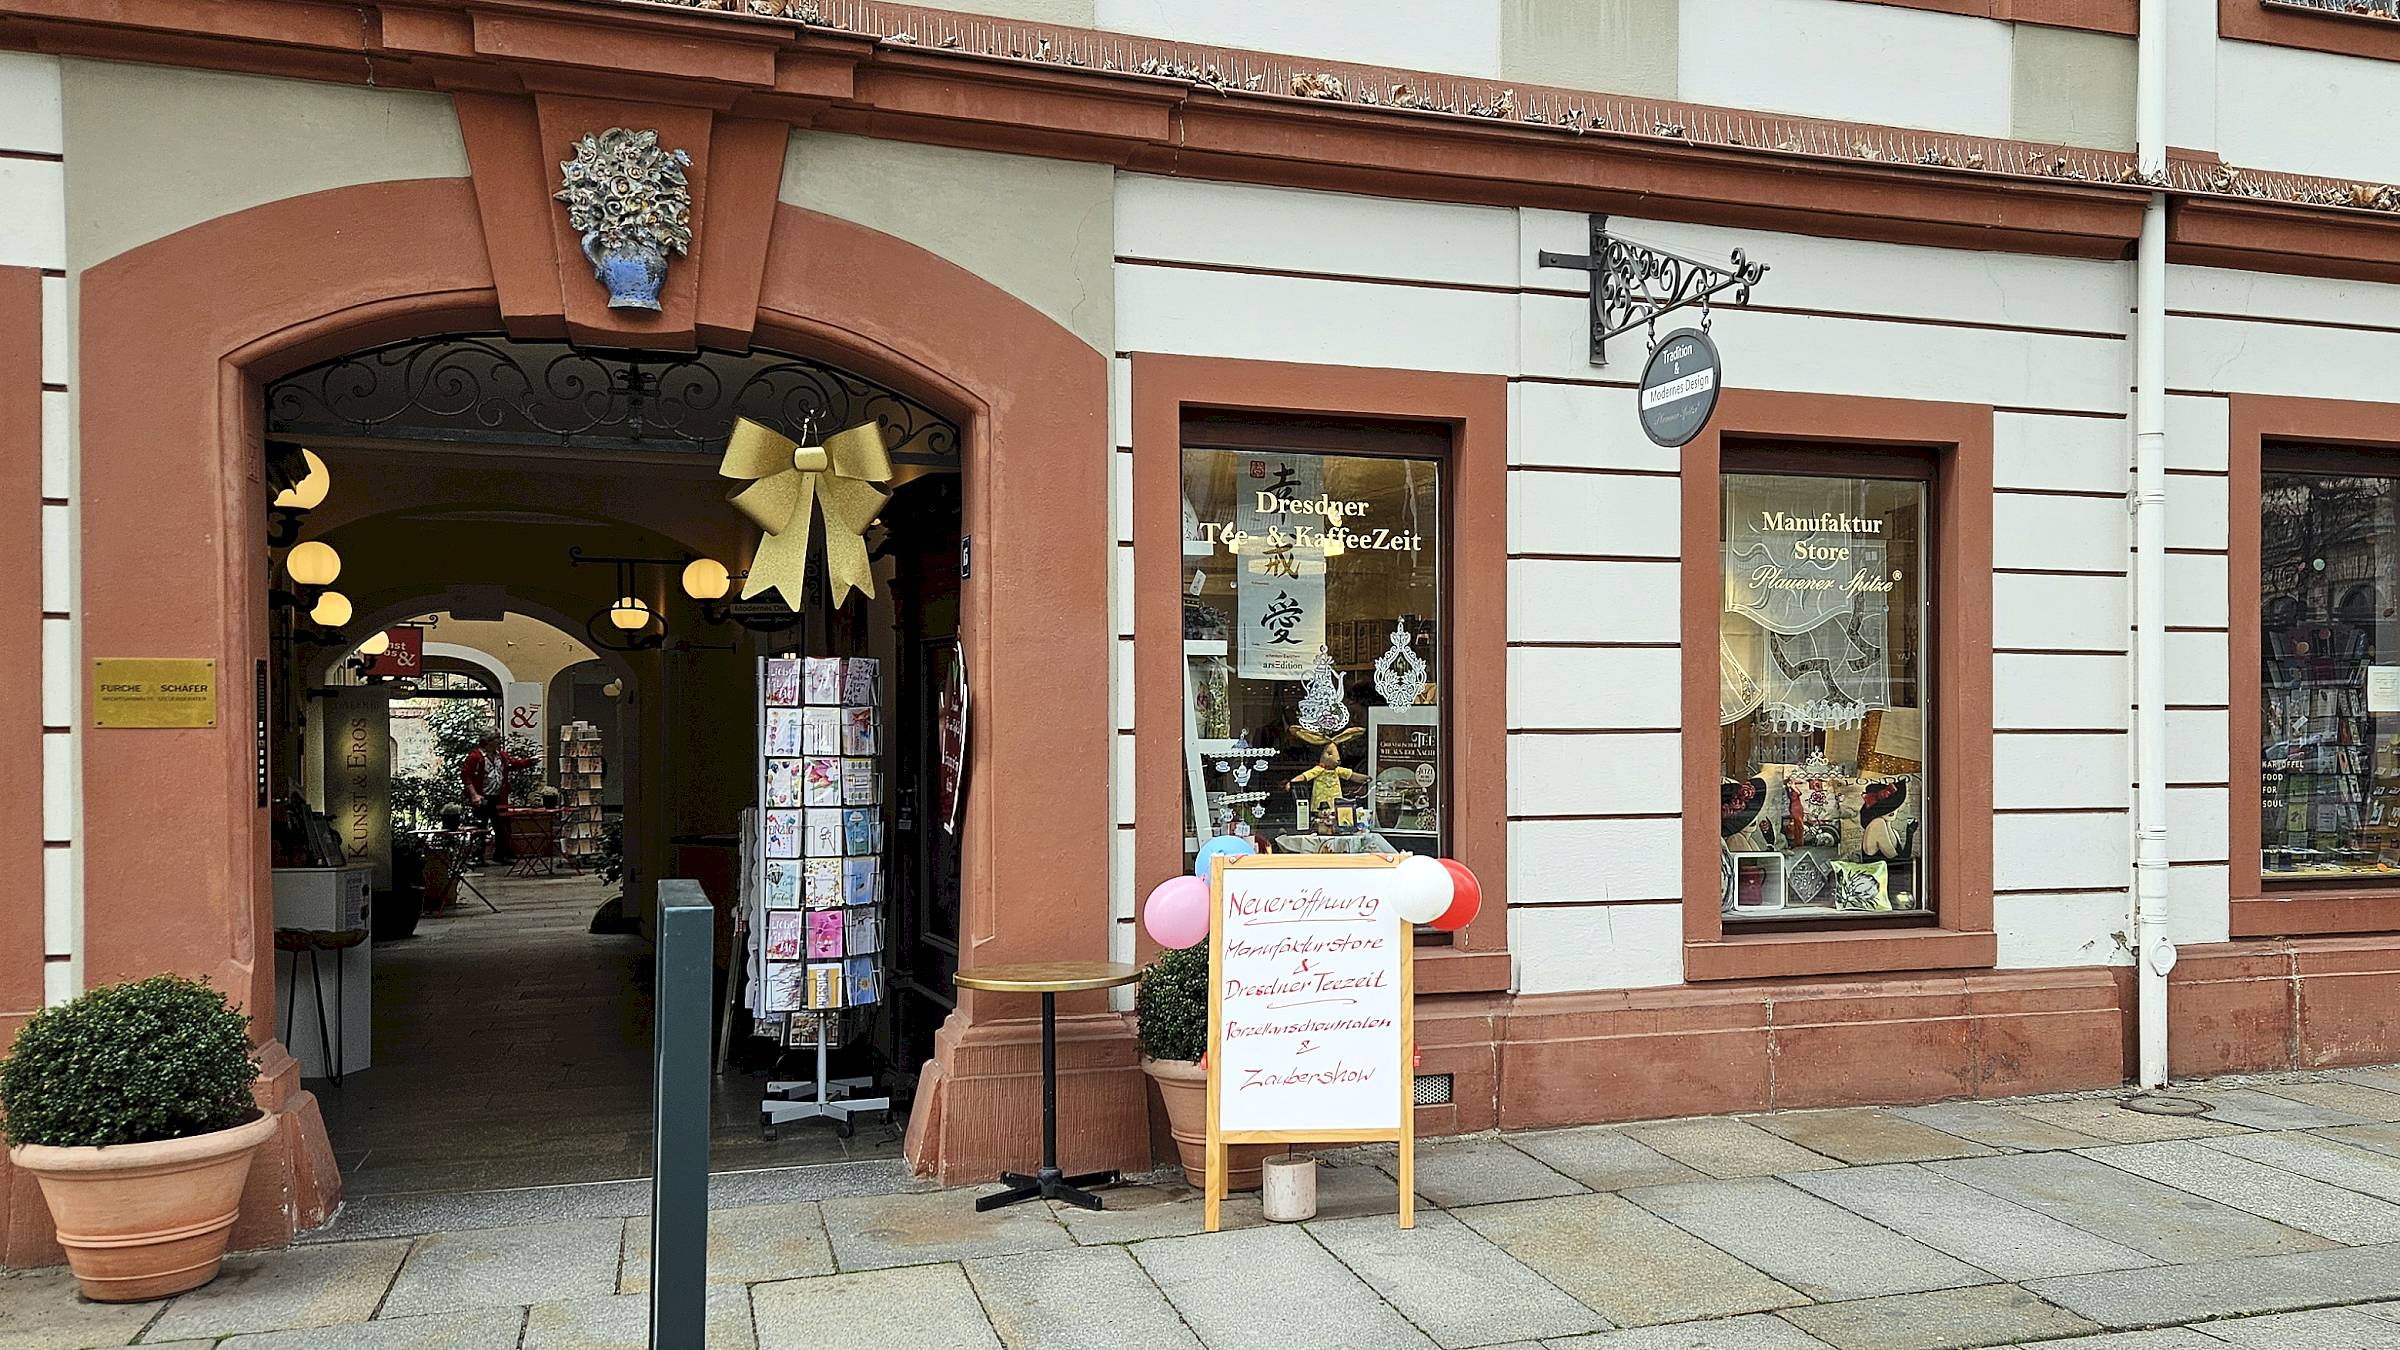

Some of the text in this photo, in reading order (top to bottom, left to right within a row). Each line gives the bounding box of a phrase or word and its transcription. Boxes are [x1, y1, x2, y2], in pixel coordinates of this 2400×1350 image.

[1662, 344, 1693, 365] Tradition
[1673, 361, 1680, 375] &
[1650, 374, 1709, 403] Modernes Design
[1255, 491, 1370, 517] Dresdner
[1761, 511, 1883, 534] Manufaktur
[1266, 524, 1289, 547] &
[1294, 524, 1422, 551] KaffeeZeit
[1794, 540, 1849, 561] Store
[1749, 564, 1834, 592] Plauener
[1261, 590, 1304, 645] 愛
[397, 651, 416, 667] &
[1262, 660, 1303, 670] arsEdition
[100, 684, 142, 693] FURCHE
[510, 706, 538, 729] &
[346, 717, 367, 771] EROS
[352, 774, 368, 789] &
[2262, 773, 2284, 782] FOOD
[2262, 785, 2277, 794] FOR
[2262, 799, 2284, 808] SOUL
[347, 792, 369, 860] KUNST
[1228, 888, 1380, 919] Neueröffnung
[1225, 932, 1384, 961] Manufakturstore
[1293, 958, 1320, 975] &
[1224, 969, 1388, 1000] Dresdner Teezeit
[1239, 1060, 1376, 1091] Zaubershow
